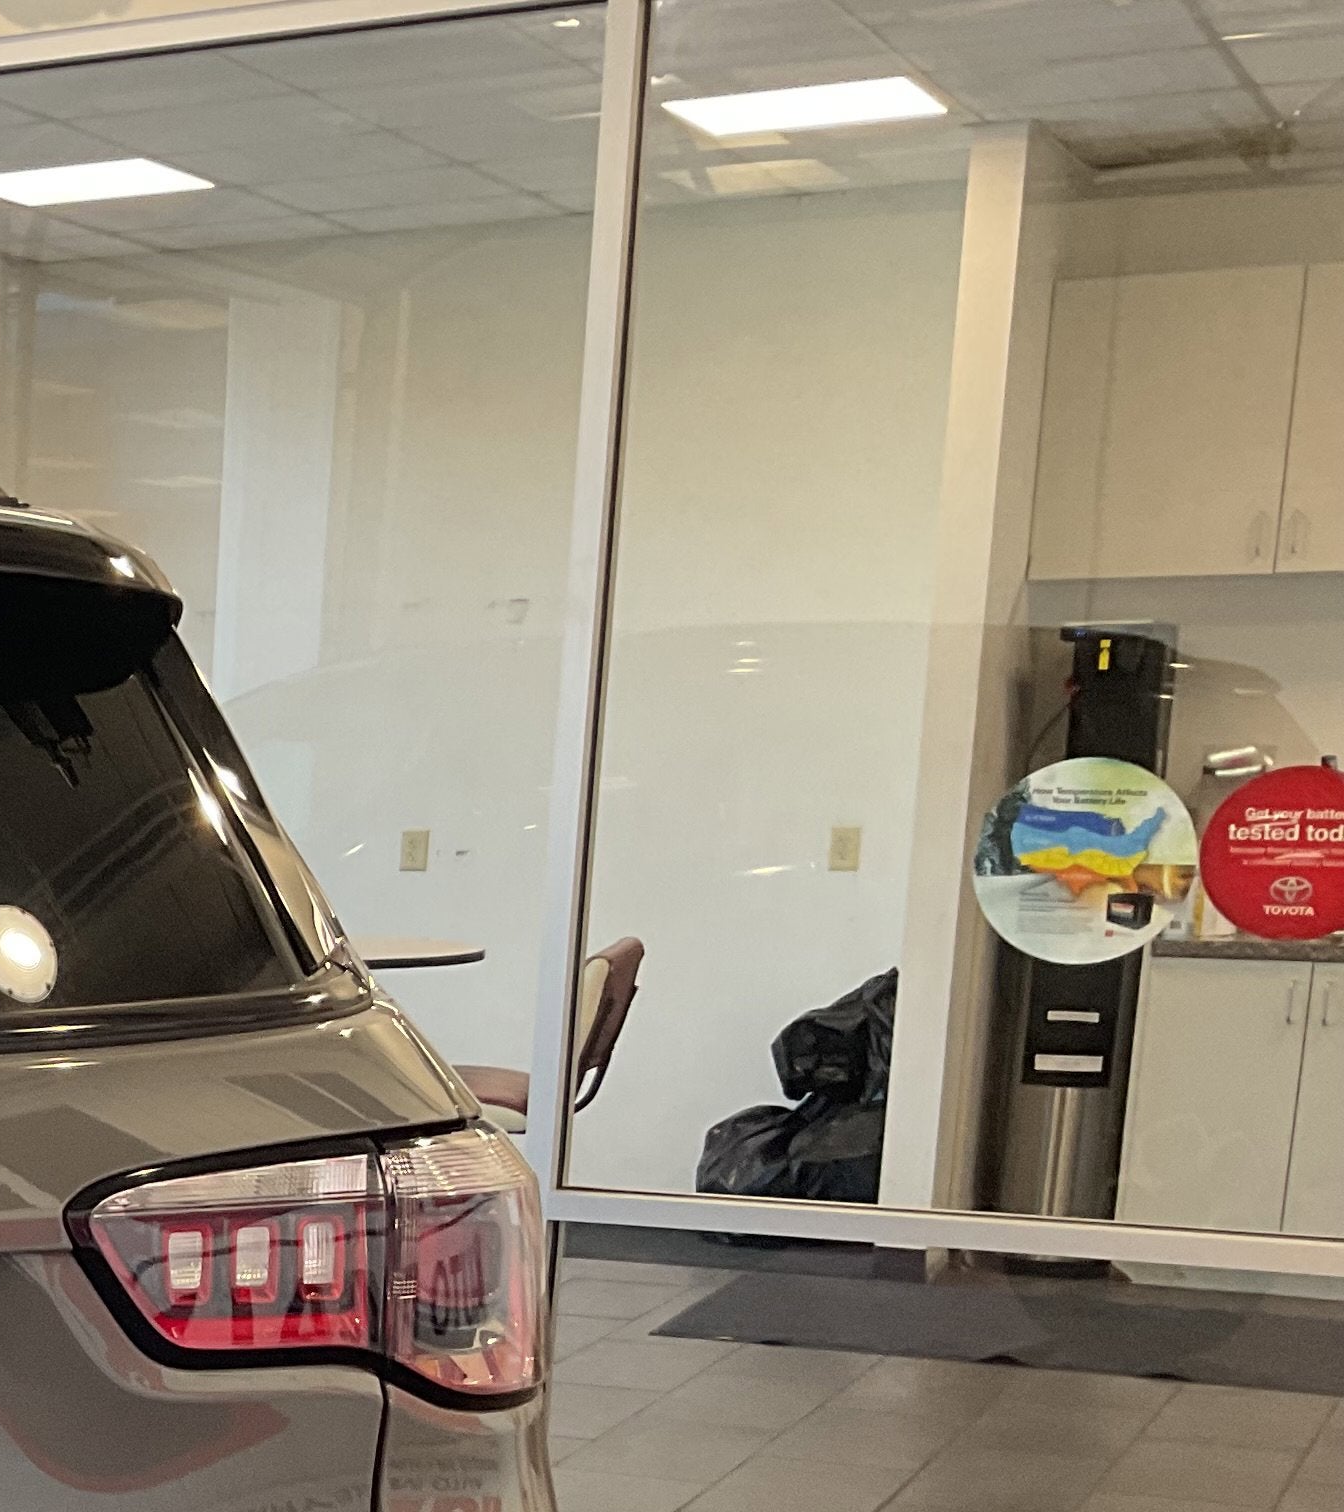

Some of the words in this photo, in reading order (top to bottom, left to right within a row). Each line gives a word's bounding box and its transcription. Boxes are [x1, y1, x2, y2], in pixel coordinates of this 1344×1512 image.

[1245, 807, 1270, 821] Get
[1272, 809, 1304, 823] your
[1305, 808, 1344, 820] batte
[1228, 823, 1300, 841] tested
[1262, 904, 1315, 916] TOYOTA
